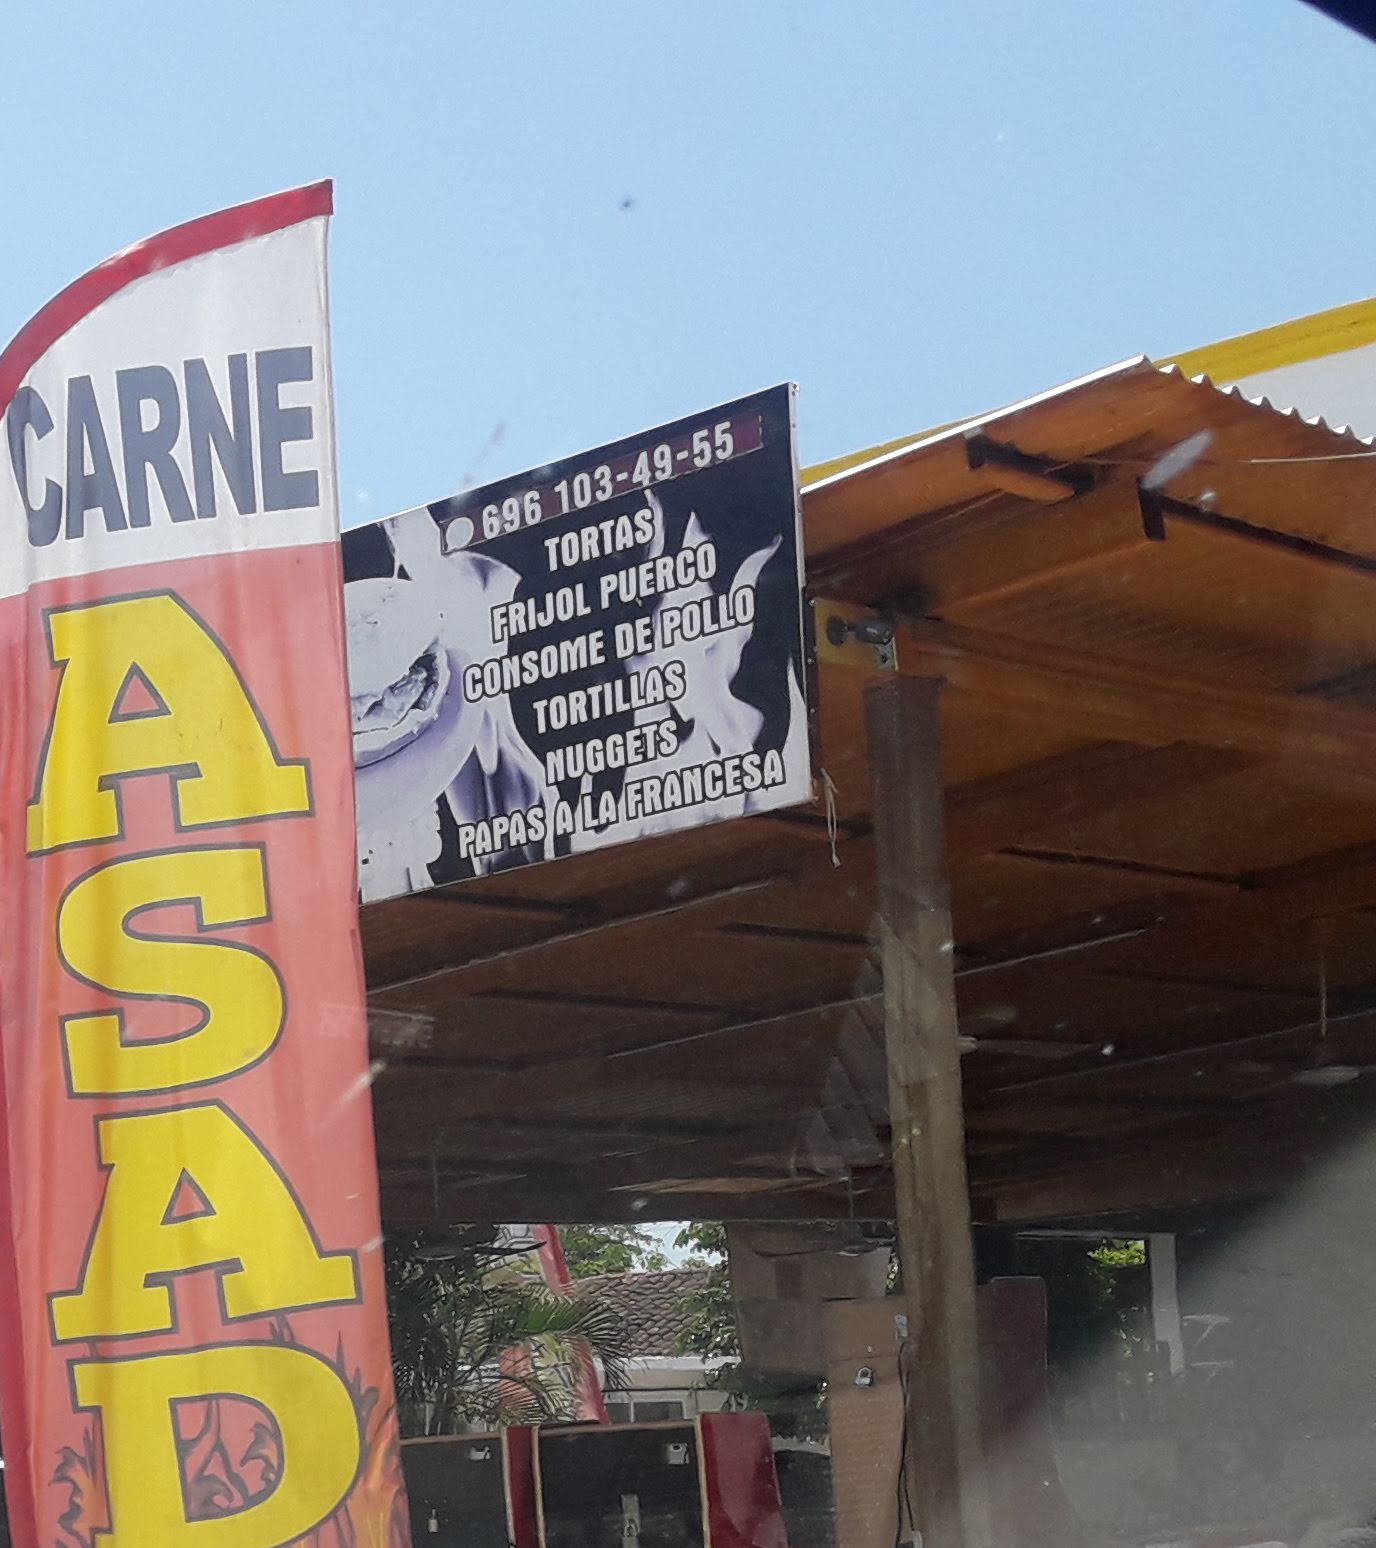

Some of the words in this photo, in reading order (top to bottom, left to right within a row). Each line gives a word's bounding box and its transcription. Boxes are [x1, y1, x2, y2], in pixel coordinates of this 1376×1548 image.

[6, 345, 321, 548] CARNE
[481, 489, 543, 540] 696
[553, 419, 736, 514] 103-49-55
[491, 584, 591, 645] FRIJOL
[599, 540, 718, 610] PUERCO
[544, 507, 657, 572] TORTAS
[463, 634, 606, 704] CONSOME
[614, 621, 653, 661] DE
[660, 585, 755, 648] POLLO
[533, 659, 686, 735] TORTILLAS
[458, 812, 547, 860] PAPAS
[548, 804, 574, 835] A
[582, 794, 625, 829] LA
[625, 748, 787, 819] FRANCESA
[545, 719, 679, 787] NUGGETS
